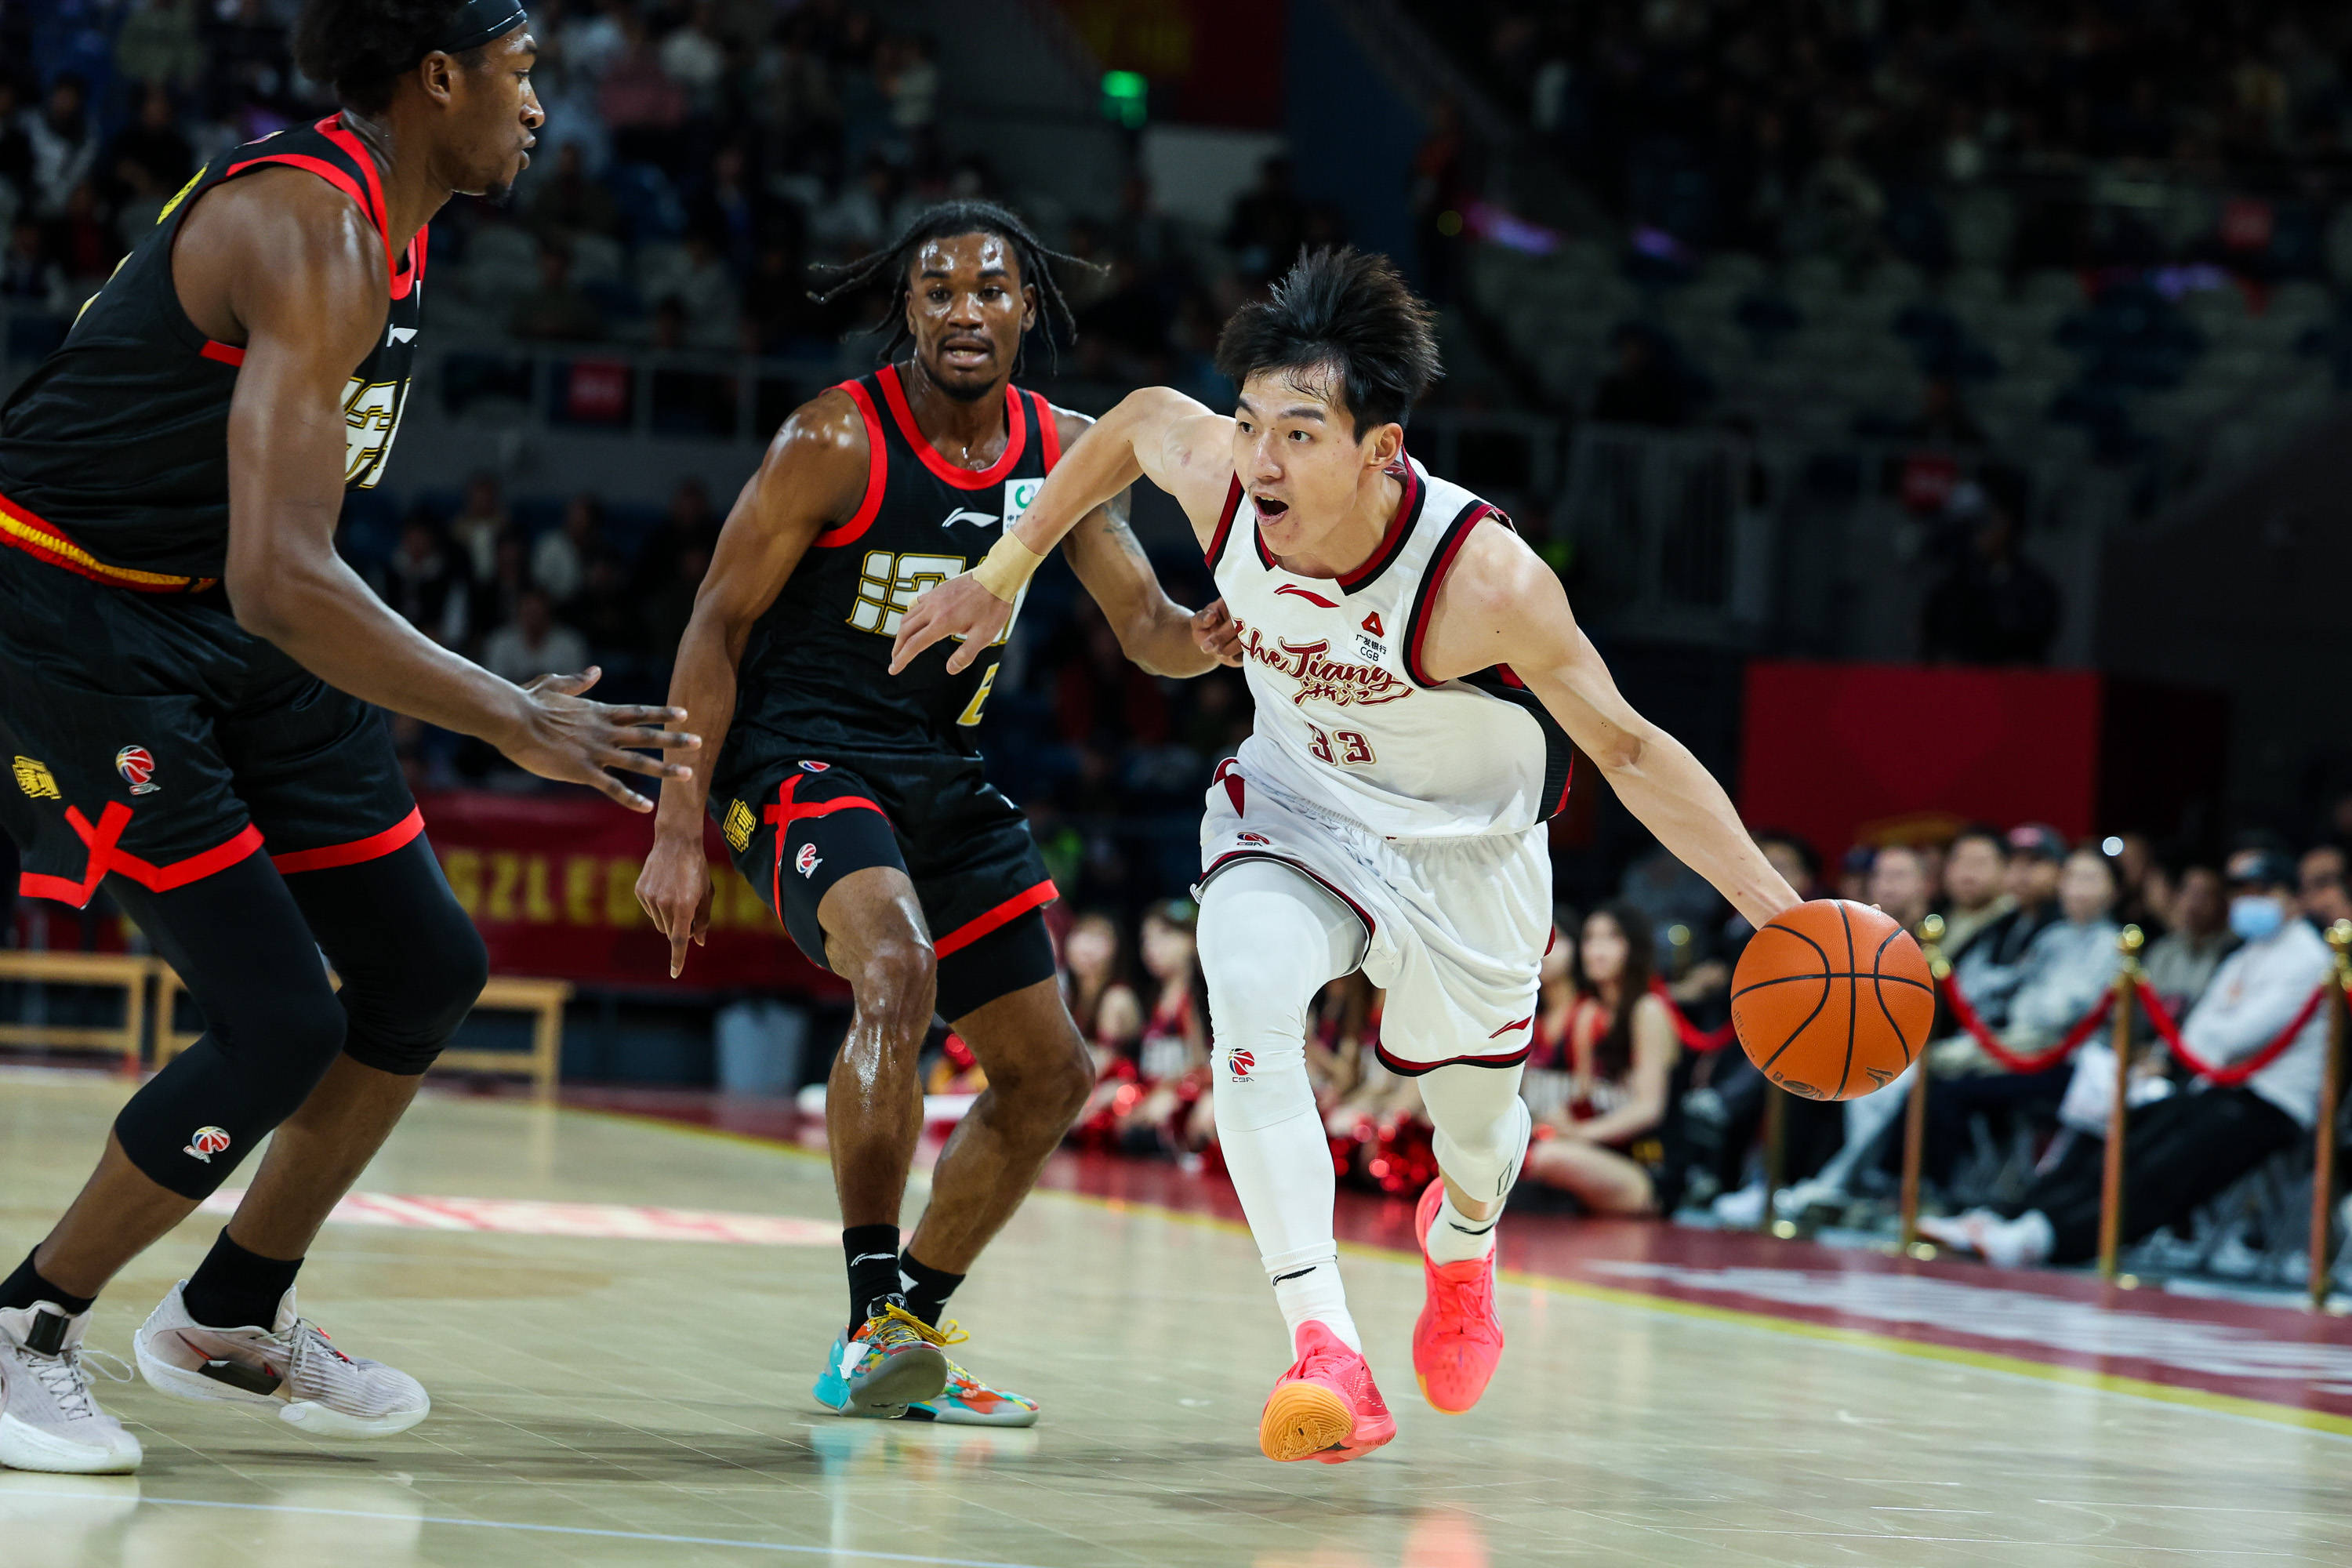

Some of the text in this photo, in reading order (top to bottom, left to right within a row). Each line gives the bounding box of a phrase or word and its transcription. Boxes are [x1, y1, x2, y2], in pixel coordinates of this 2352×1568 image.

[1356, 633, 1387, 655] 广发银行
[1360, 646, 1379, 662] CGB
[1305, 720, 1377, 766] 33
